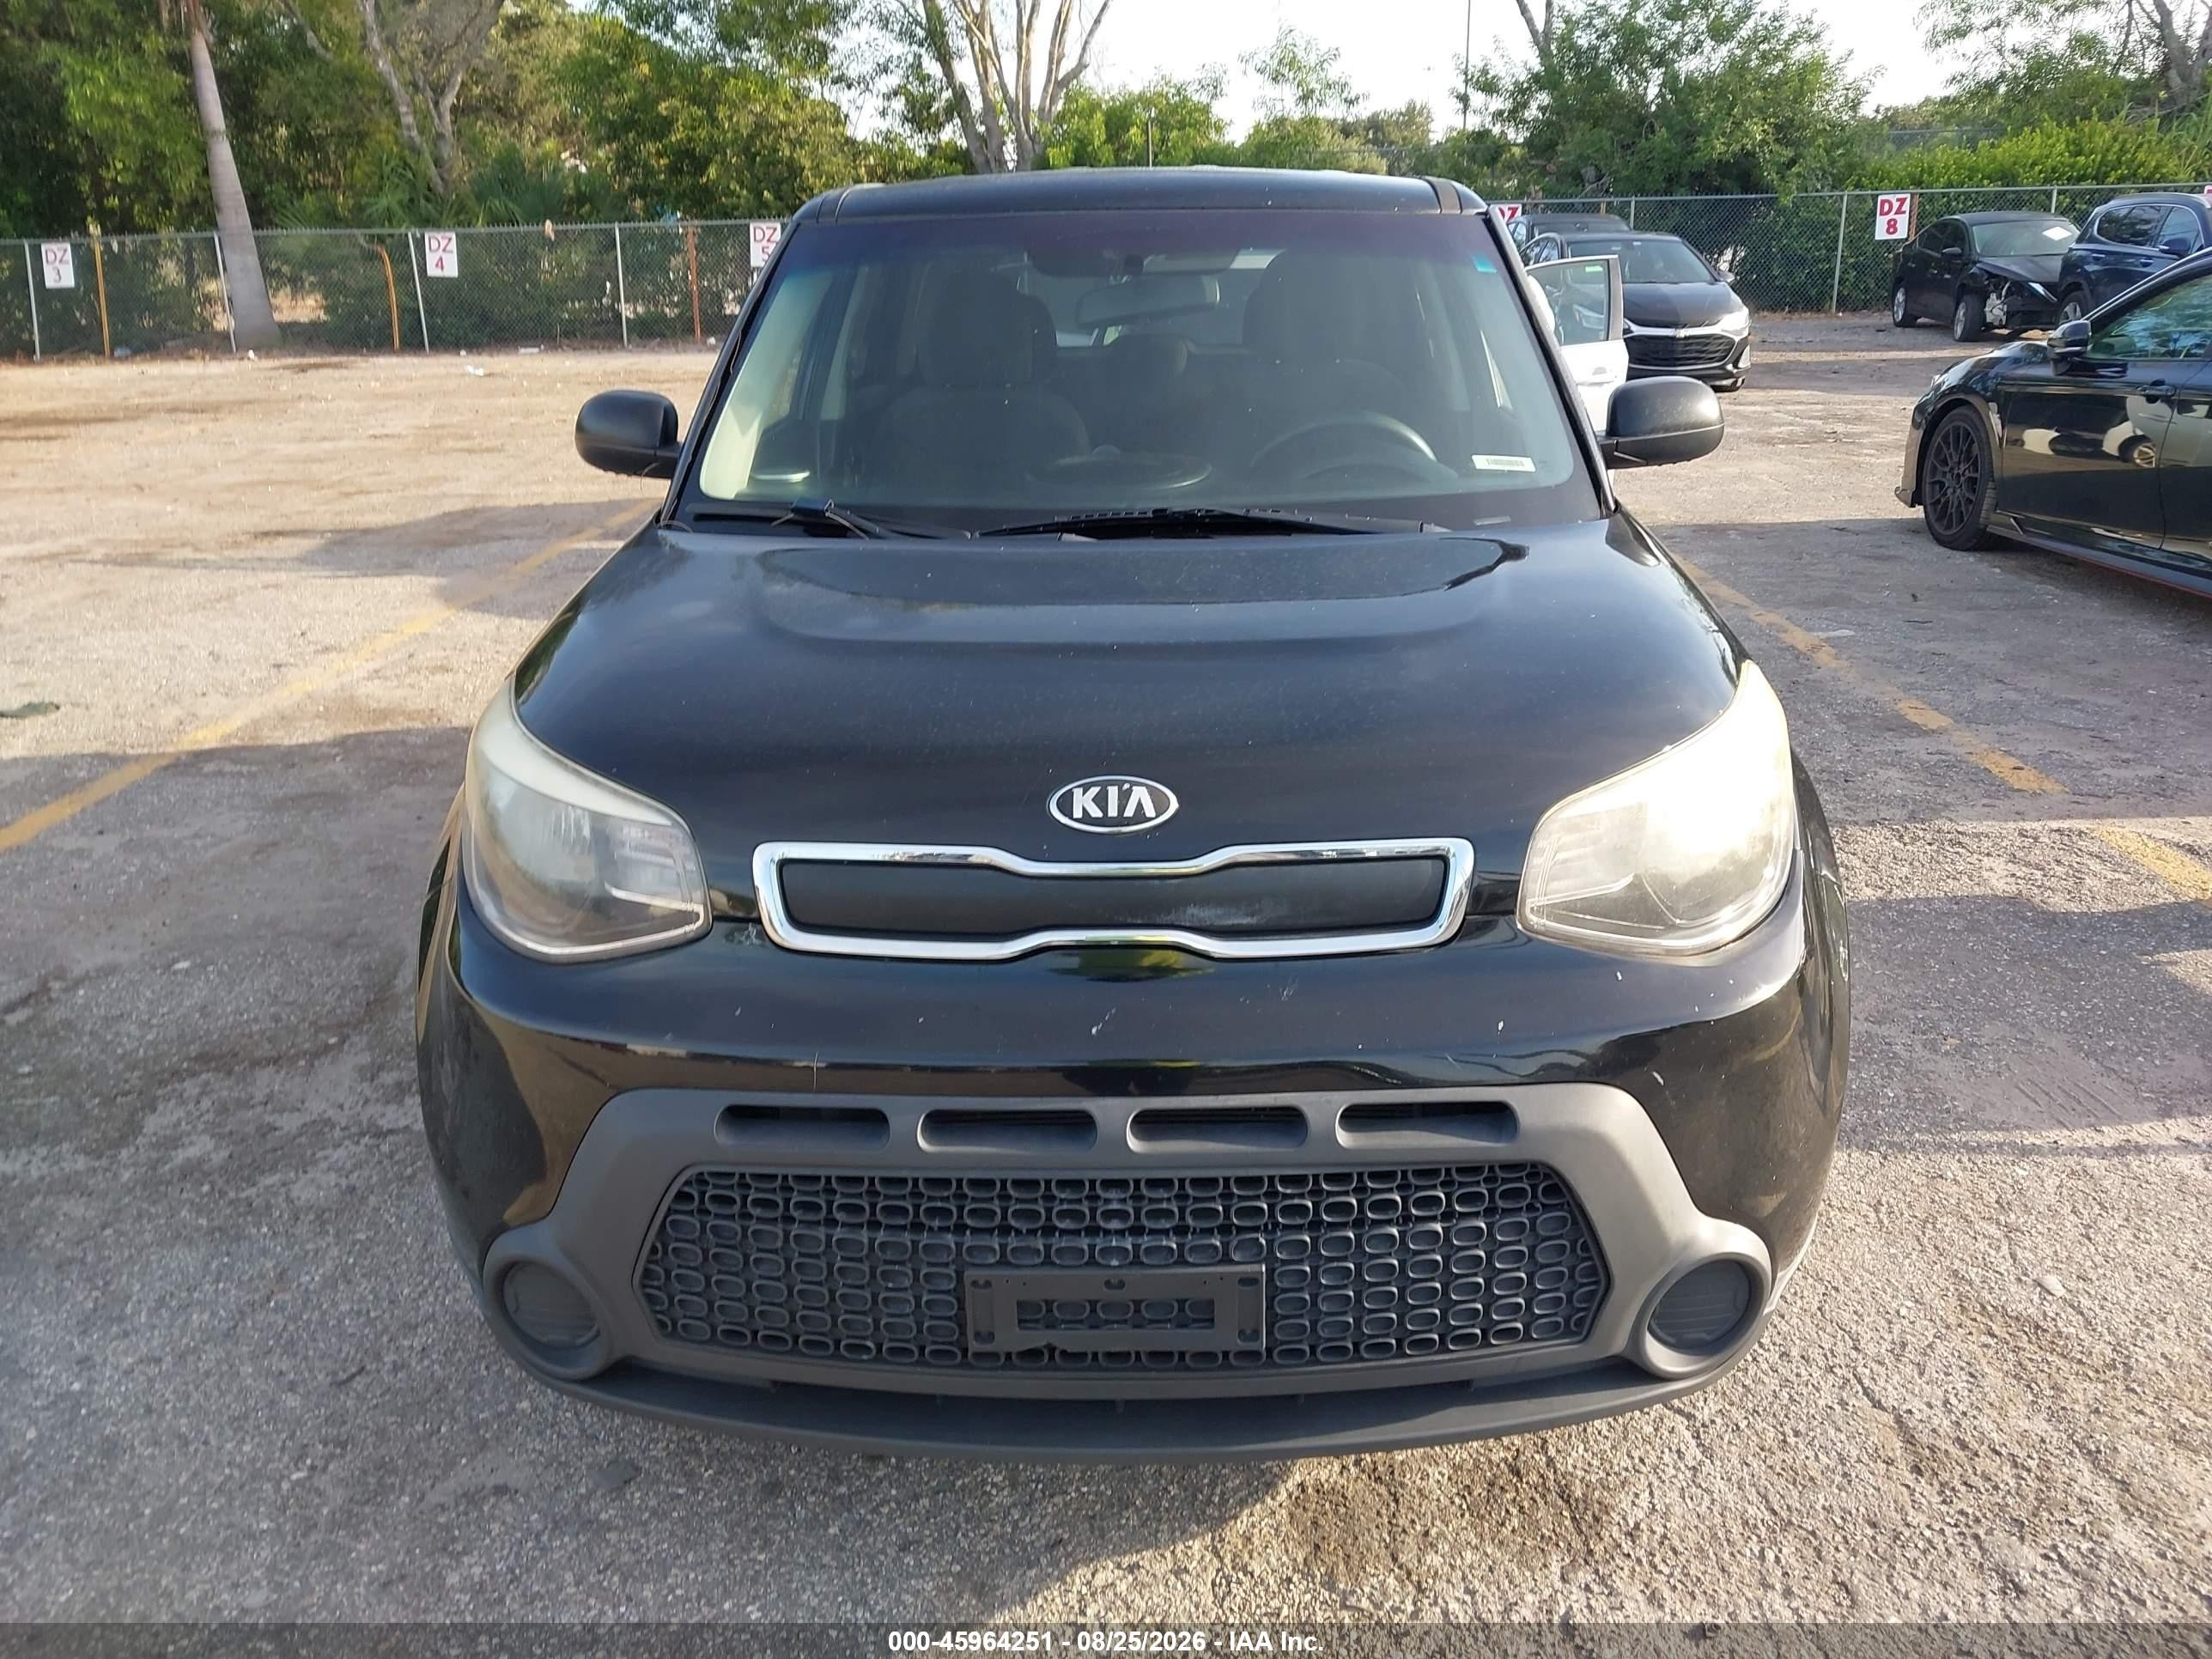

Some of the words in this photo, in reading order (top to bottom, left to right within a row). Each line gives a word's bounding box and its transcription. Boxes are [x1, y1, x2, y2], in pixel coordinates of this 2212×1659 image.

[1879, 197, 1908, 216] DZ
[753, 226, 779, 244] DZ
[1886, 217, 1899, 235] 8
[428, 235, 454, 253] DZ
[45, 247, 70, 264] DZ
[762, 245, 770, 263] 5
[435, 255, 445, 272] 4
[52, 266, 62, 283] 3
[1072, 786, 1157, 818] KIA
